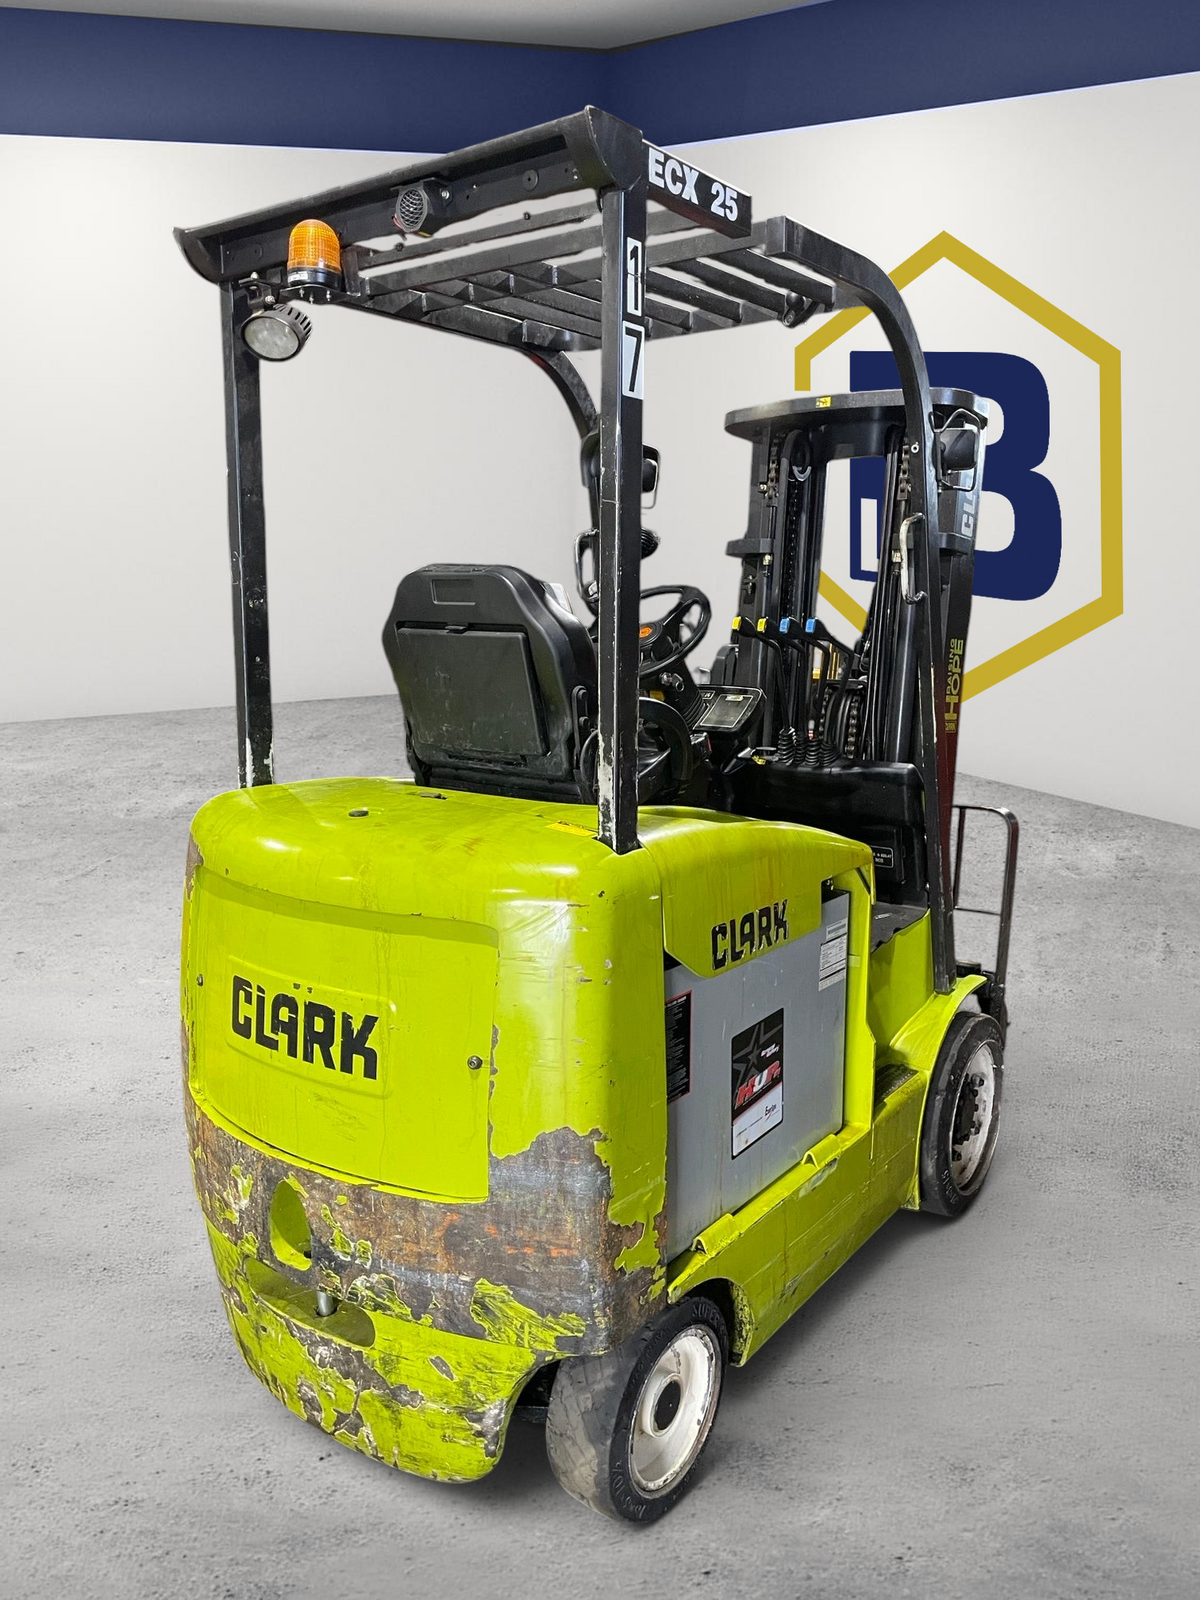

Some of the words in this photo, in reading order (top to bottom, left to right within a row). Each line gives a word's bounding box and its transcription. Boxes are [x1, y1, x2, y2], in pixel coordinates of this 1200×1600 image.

[649, 146, 699, 205] ECX
[710, 181, 738, 221] 25
[944, 639, 964, 720] HOPE
[711, 898, 789, 971] CLARK
[232, 974, 379, 1081] CLARK
